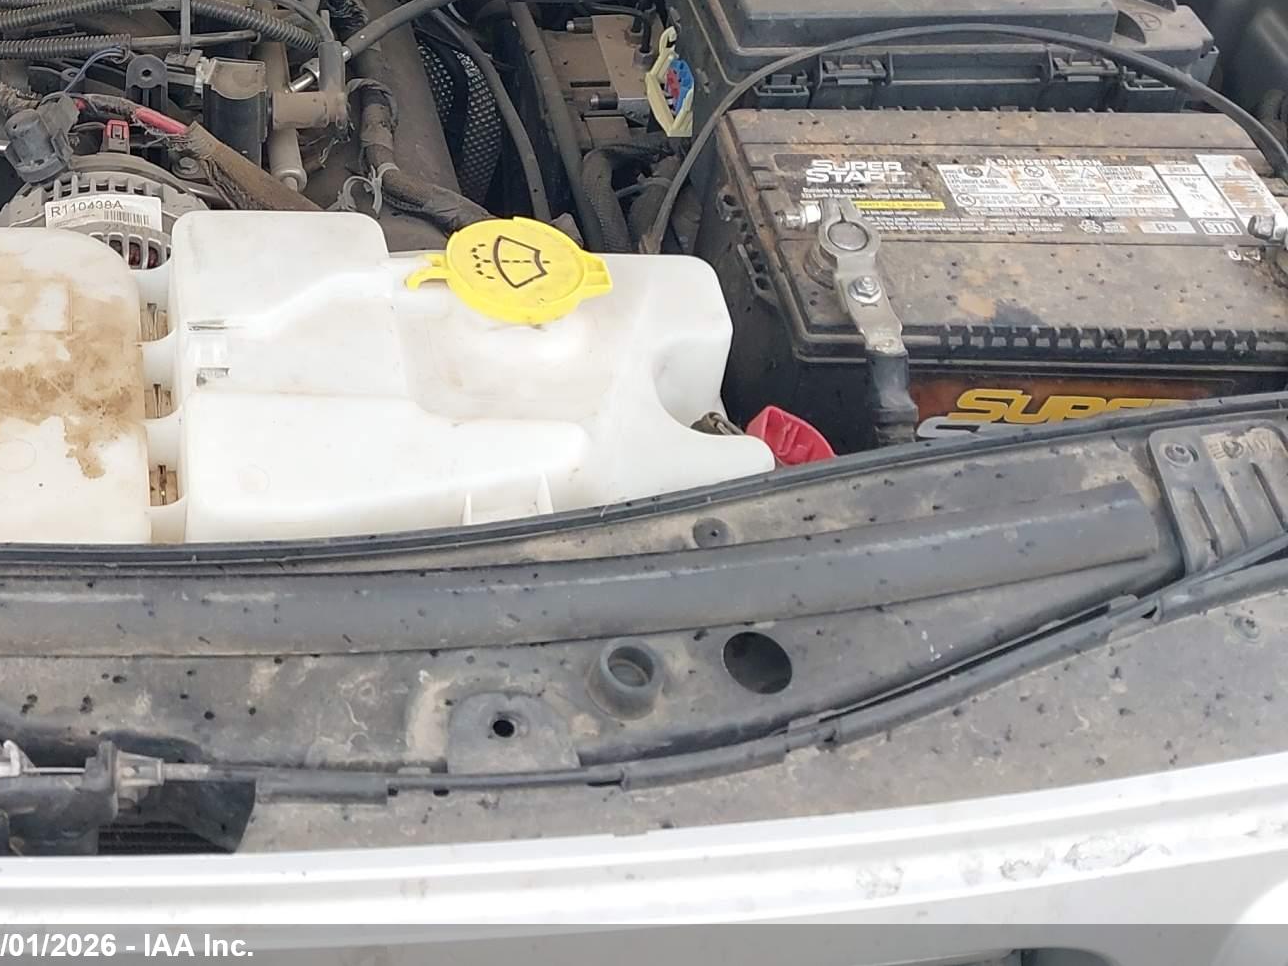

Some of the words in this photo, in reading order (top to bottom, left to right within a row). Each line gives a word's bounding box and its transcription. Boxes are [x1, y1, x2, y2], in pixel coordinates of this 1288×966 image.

[811, 159, 902, 172] SUPER
[806, 168, 906, 184] START
[50, 200, 123, 218] R110438A
[1155, 223, 1177, 232] Pb
